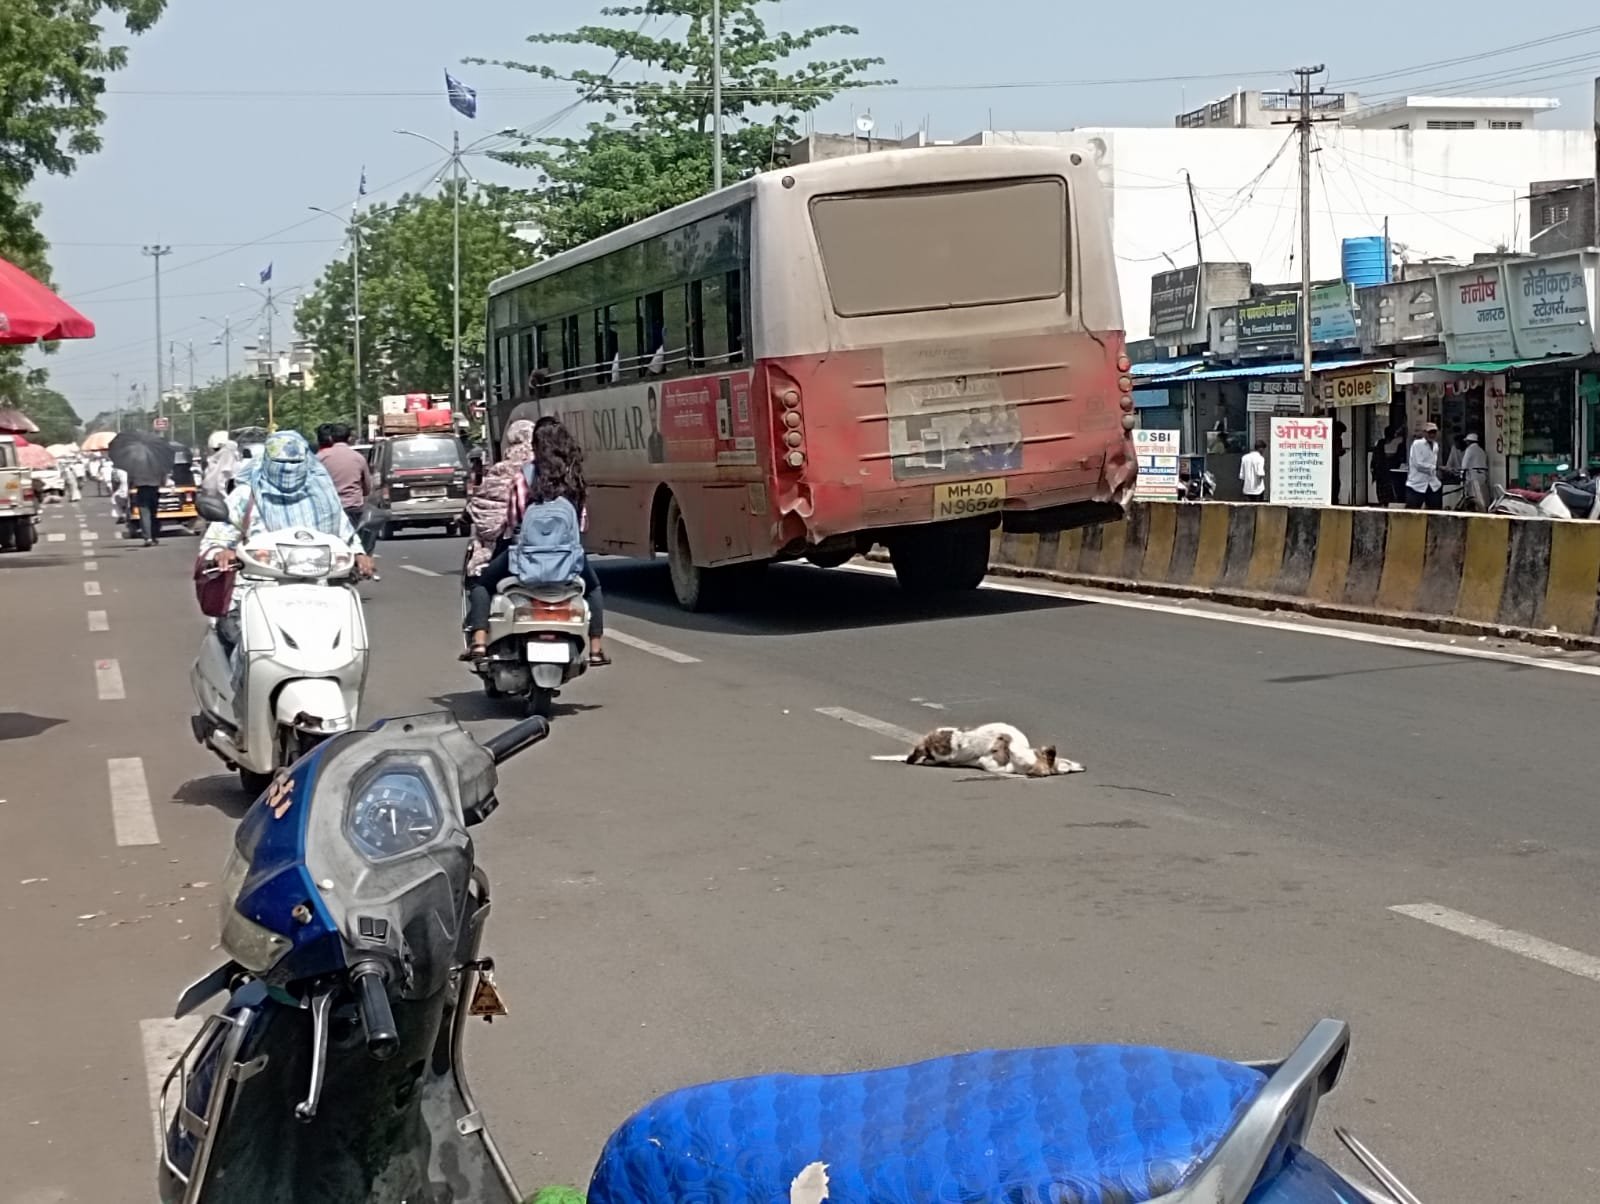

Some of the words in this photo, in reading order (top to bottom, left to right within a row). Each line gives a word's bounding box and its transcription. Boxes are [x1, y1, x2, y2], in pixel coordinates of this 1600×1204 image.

[1459, 274, 1497, 305] मनीष
[1521, 267, 1572, 298] मेडीकल
[1476, 306, 1506, 323] जनरल
[592, 405, 646, 451] SOLAR
[1149, 432, 1171, 442] SBI
[1274, 420, 1329, 440] औषधे
